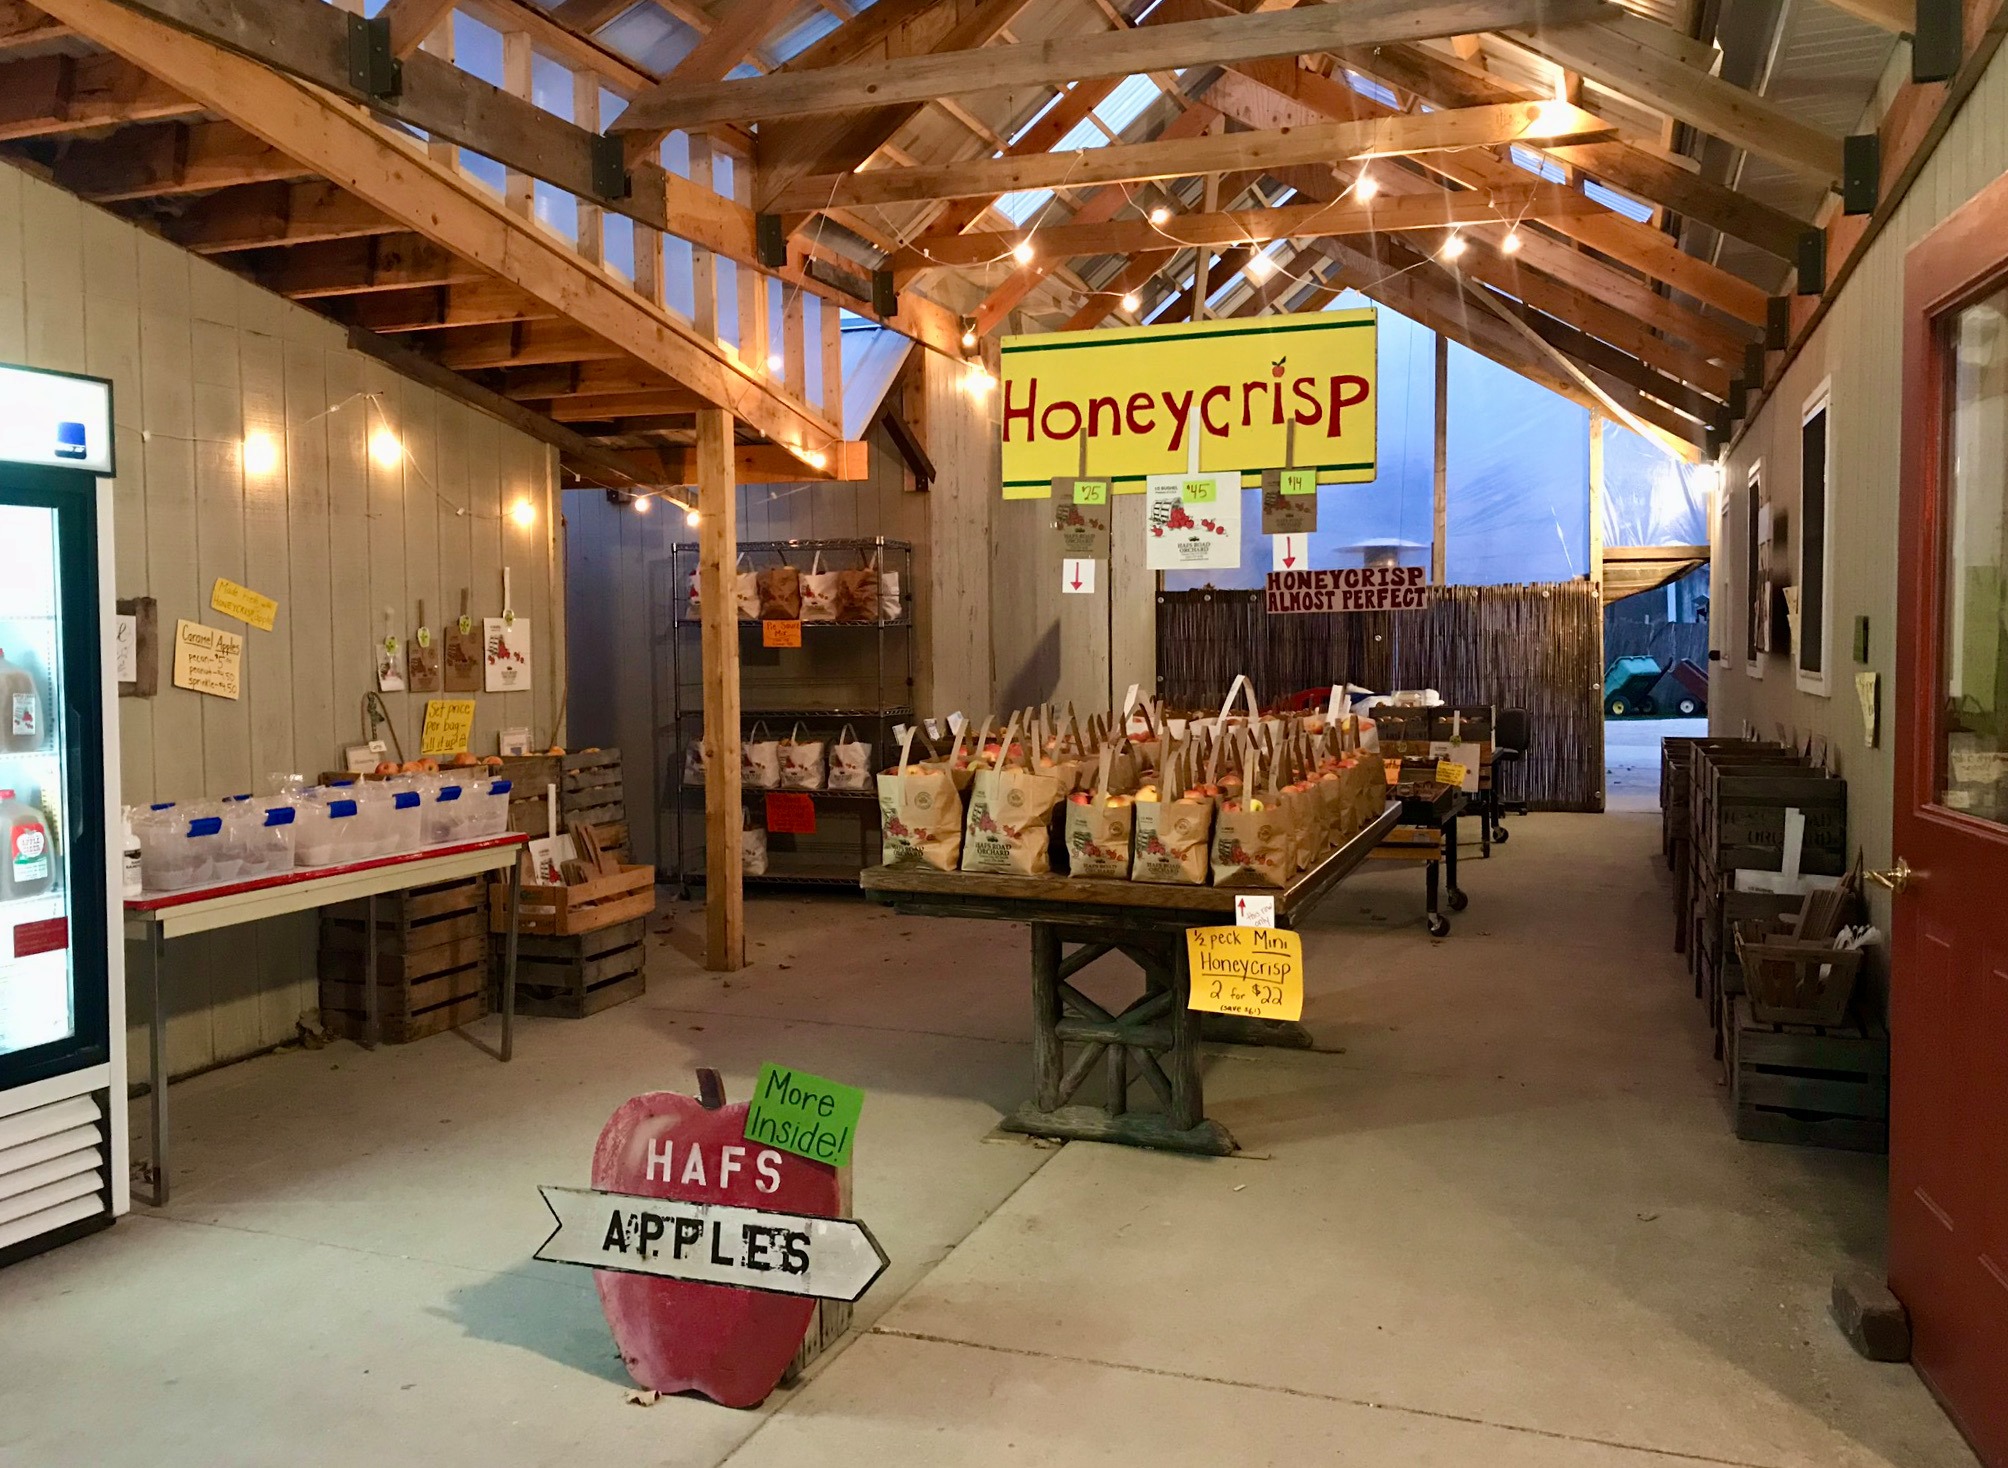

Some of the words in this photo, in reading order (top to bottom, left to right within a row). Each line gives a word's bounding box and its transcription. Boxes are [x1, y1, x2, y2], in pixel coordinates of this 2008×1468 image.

[1002, 357, 1371, 452] Honeycrisp
[1186, 483, 1211, 499] $45
[1287, 476, 1303, 491] $14
[1267, 567, 1423, 591] HONEYCRISP
[1267, 590, 1335, 612] ALMOST
[1342, 587, 1426, 609] PERFECT
[182, 624, 214, 647] Caramel
[215, 634, 240, 655] Apples
[429, 703, 446, 718] Set
[447, 703, 471, 719] price
[425, 721, 440, 736] per
[993, 843, 1012, 851] ROAD
[1210, 930, 1242, 950] peck
[1254, 930, 1288, 950] Mini
[1200, 951, 1291, 985] Honeycrisp
[1210, 979, 1222, 1000] 2
[1230, 987, 1246, 1000] for
[1251, 983, 1283, 1006] $22
[1220, 1004, 1242, 1012] (save
[764, 1068, 835, 1117] More
[750, 1106, 849, 1162] Inside!
[645, 1138, 783, 1194] HAFS
[602, 1209, 812, 1275] APPLES
